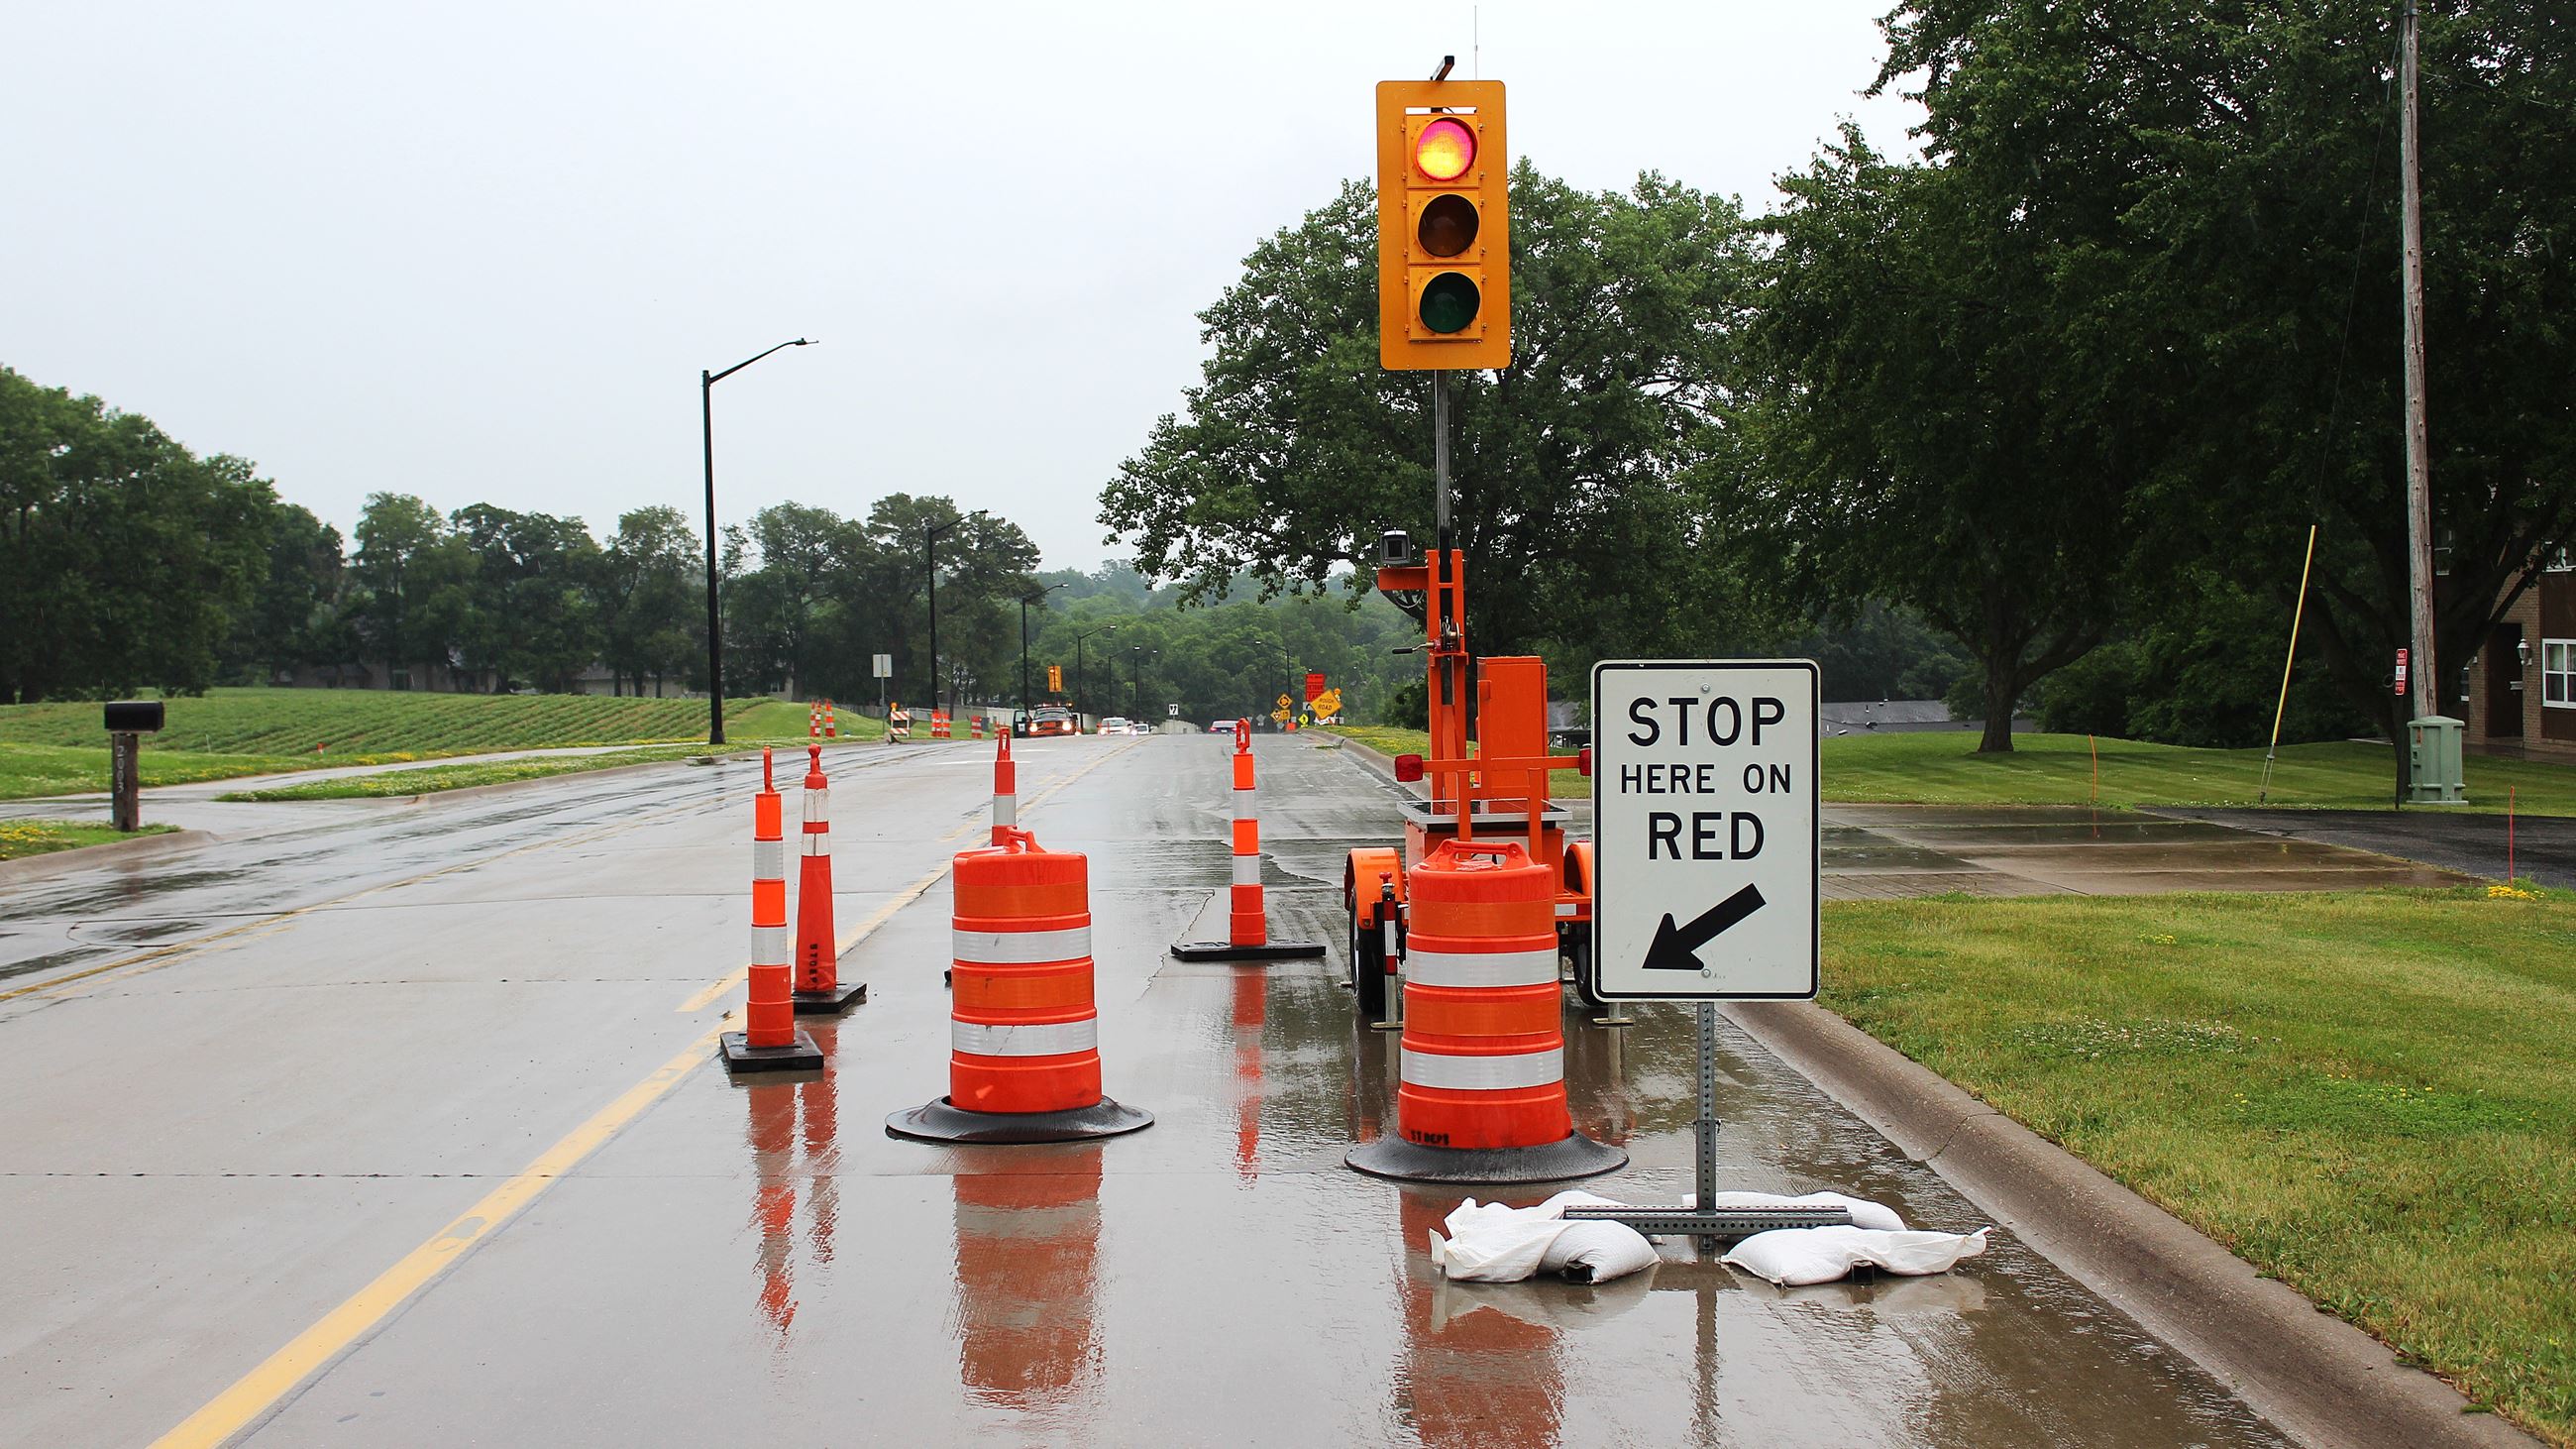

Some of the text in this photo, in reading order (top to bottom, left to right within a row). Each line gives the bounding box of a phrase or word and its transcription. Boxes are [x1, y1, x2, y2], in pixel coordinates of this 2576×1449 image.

[1627, 697, 1785, 746] STOP
[1621, 763, 1791, 794] HERE ON
[1649, 812, 1765, 860] RED
